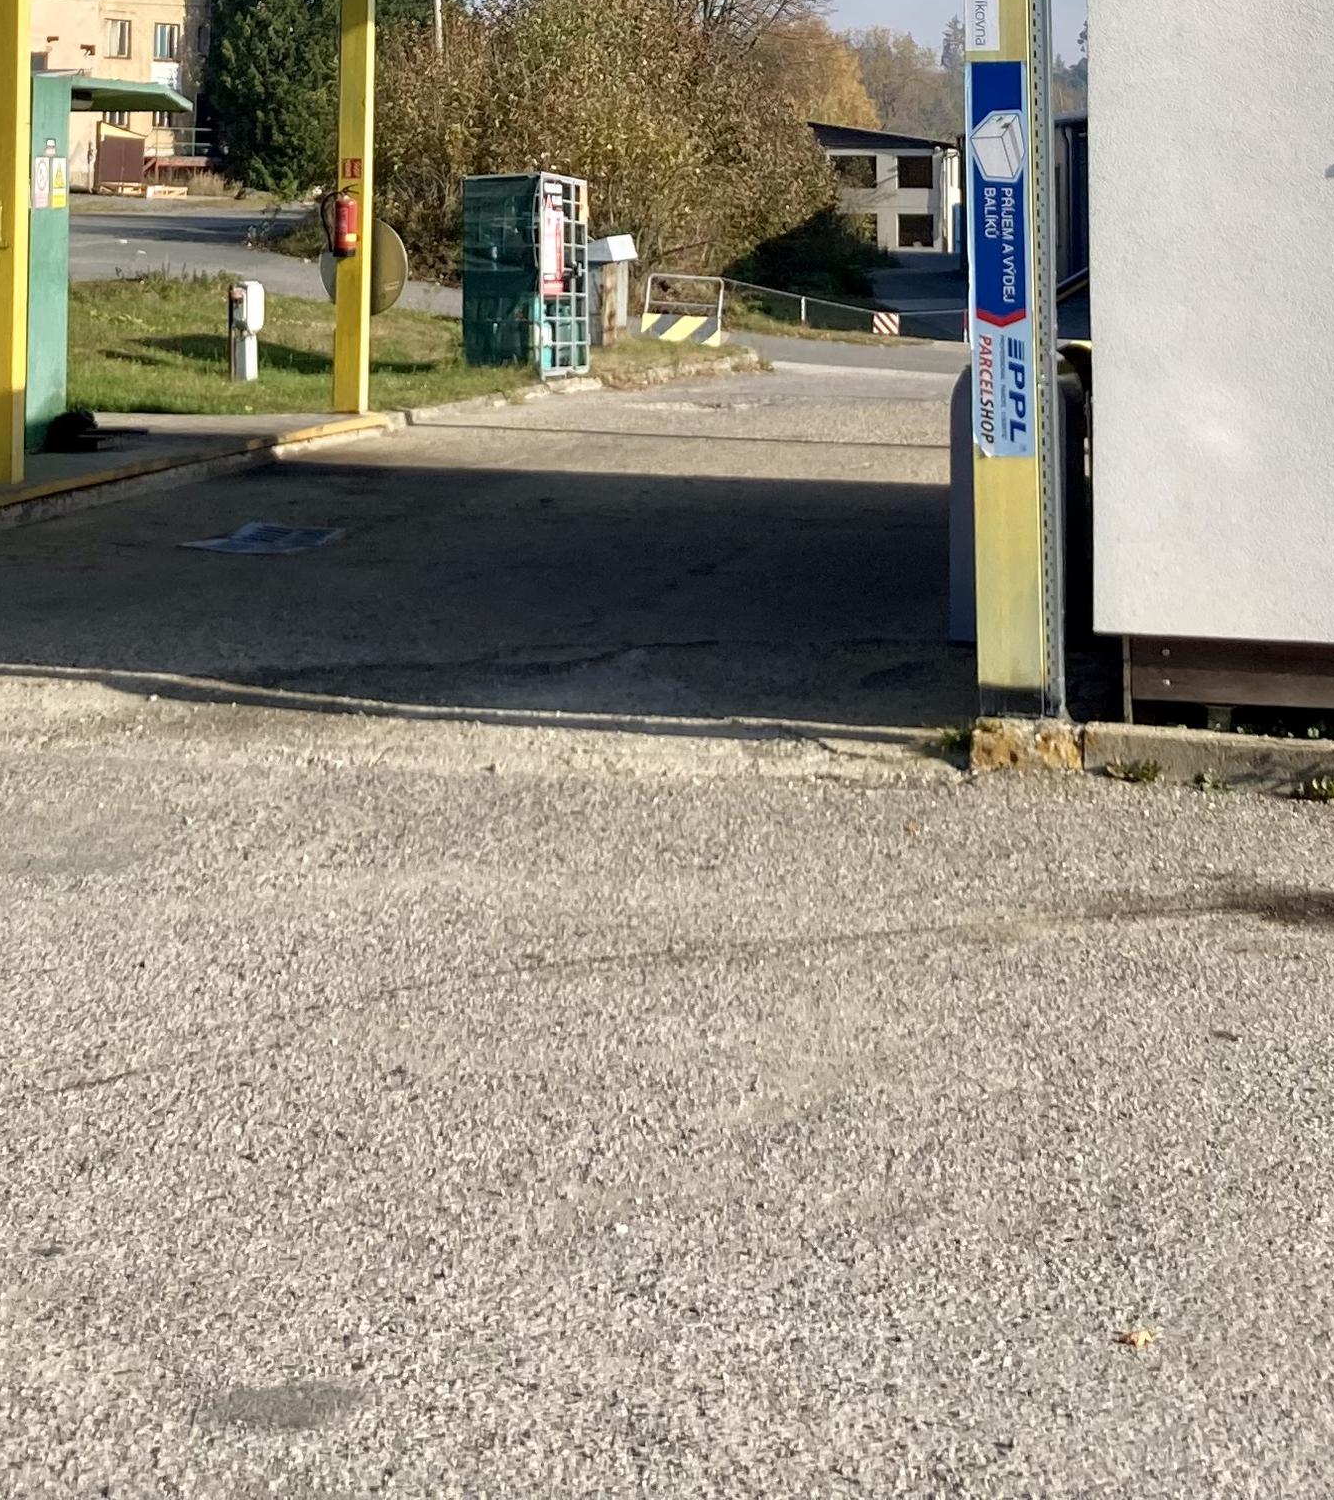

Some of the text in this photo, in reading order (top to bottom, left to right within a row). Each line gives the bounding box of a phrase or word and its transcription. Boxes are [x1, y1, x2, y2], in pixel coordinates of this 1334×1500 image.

[984, 187, 999, 239] BALÍKŮ
[1001, 187, 1018, 303] PŘÍJEM A VÝDEJ
[979, 334, 995, 444] PARCELSHOP
[1008, 361, 1027, 443] PPL
